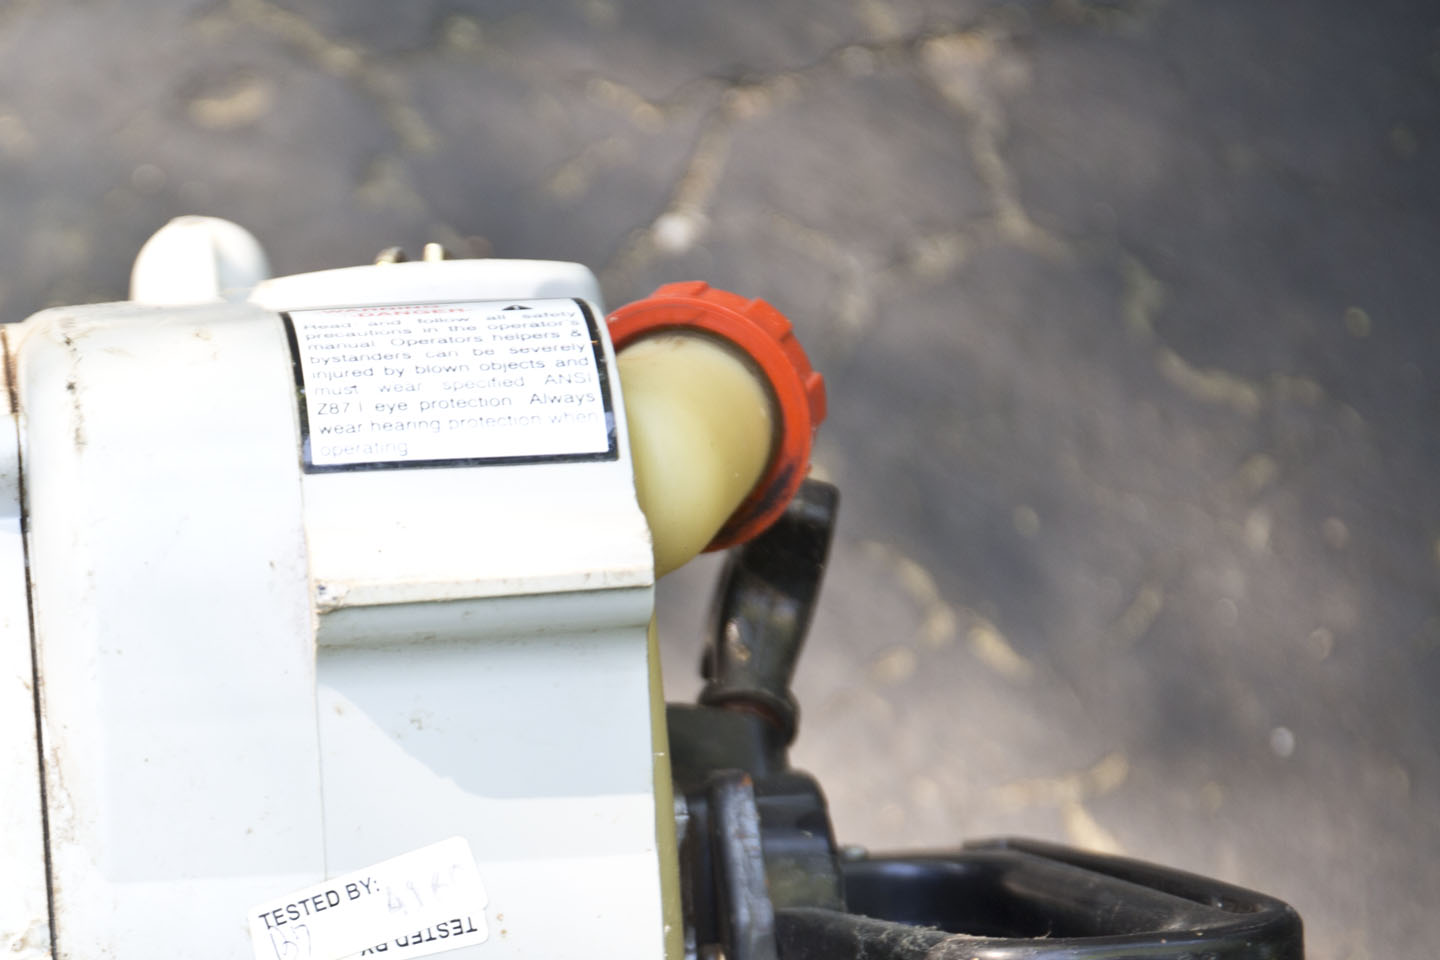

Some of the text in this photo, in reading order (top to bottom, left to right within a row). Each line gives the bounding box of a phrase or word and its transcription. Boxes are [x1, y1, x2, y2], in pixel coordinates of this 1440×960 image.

[306, 328, 412, 341] precautions
[423, 325, 438, 333] in
[448, 324, 477, 332] the
[368, 319, 402, 327] and
[308, 340, 375, 350] manual
[492, 332, 561, 342] helpers
[570, 329, 582, 337] &
[310, 343, 586, 366] bystanders can be severely
[312, 356, 589, 381] injured by blown objects and
[314, 371, 592, 396] must wear specified ANSI
[375, 400, 409, 415] eye
[419, 396, 513, 413] protection
[529, 392, 596, 406] Always
[320, 411, 600, 435] wear hearing protection when
[258, 889, 341, 931] TESTED
[345, 877, 381, 902] BY:
